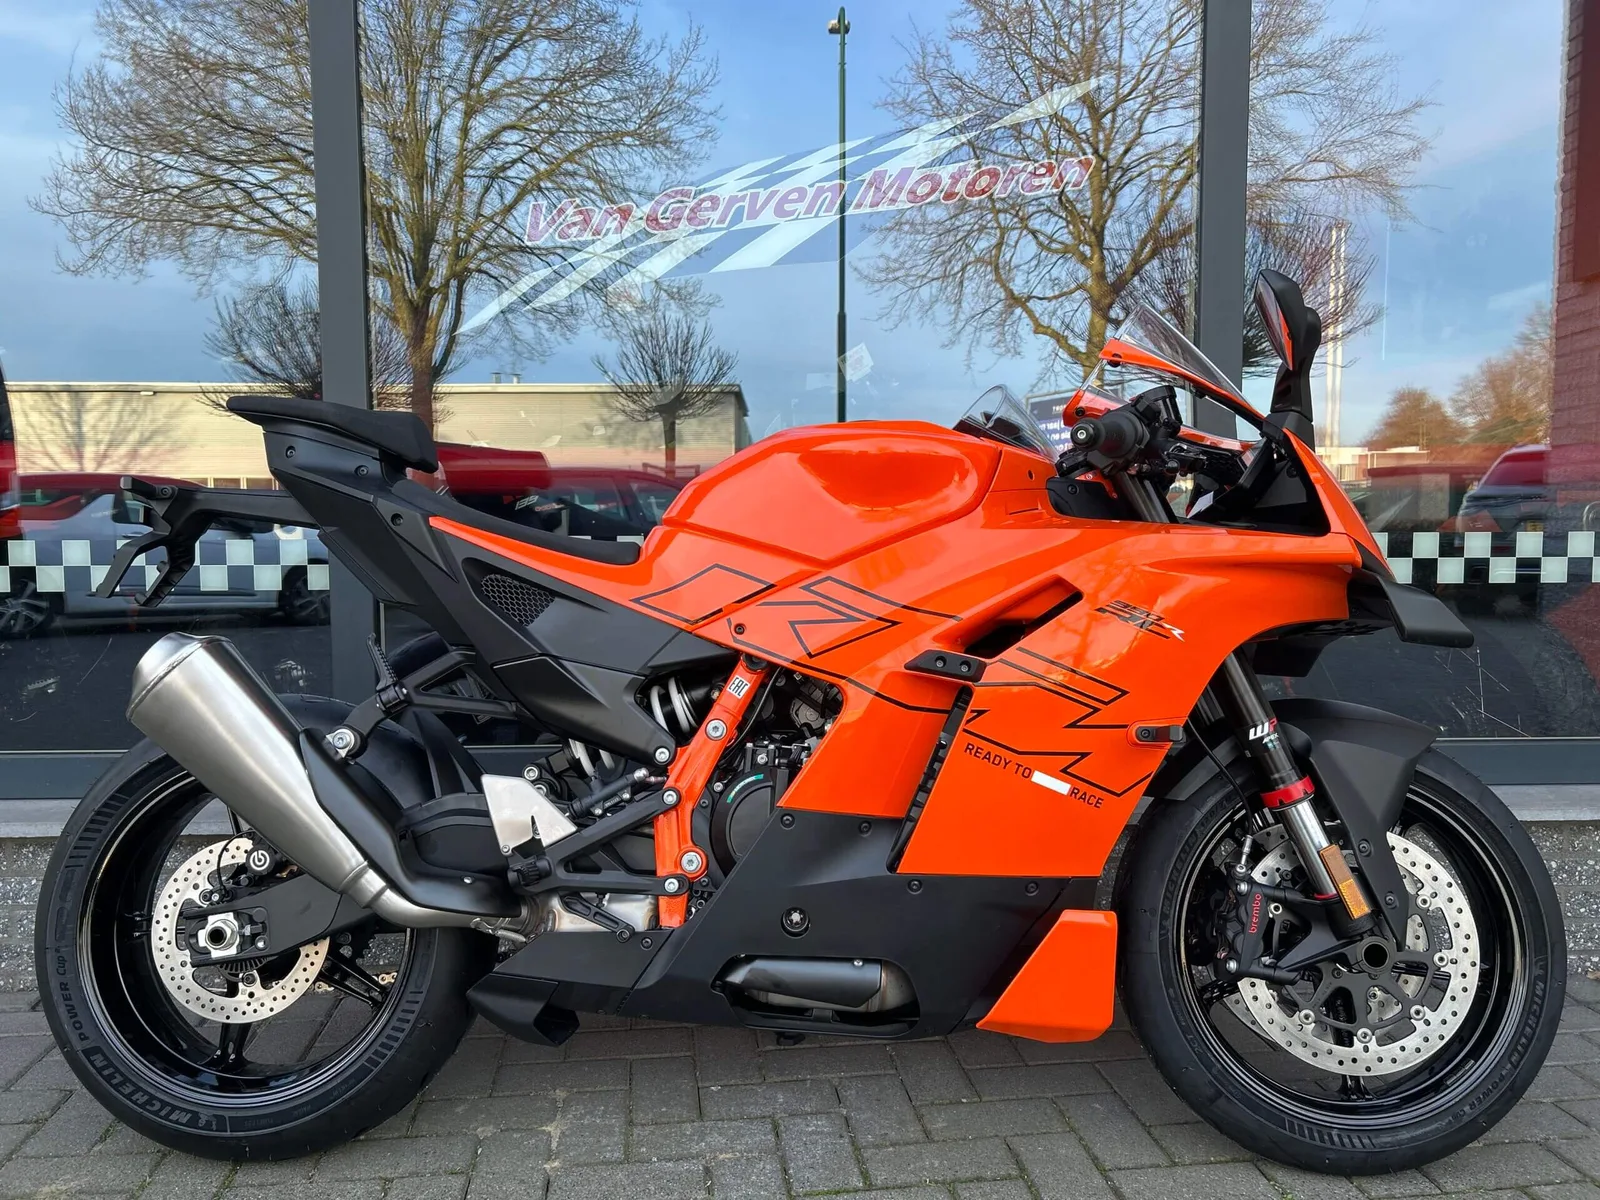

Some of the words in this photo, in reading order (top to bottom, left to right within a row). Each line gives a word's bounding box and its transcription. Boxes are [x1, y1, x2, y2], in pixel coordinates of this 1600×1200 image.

[524, 198, 635, 245] Van
[644, 180, 845, 234] Gerven
[853, 153, 1096, 211] Motoren
[1248, 717, 1278, 741] WP
[964, 742, 1011, 770] READY
[1014, 763, 1032, 779] TO
[1069, 787, 1104, 809] RACE
[1248, 893, 1262, 933] brembo
[59, 981, 89, 1042] POWER
[1510, 980, 1545, 1067] MICHELIN
[90, 1053, 192, 1124] MICHELIN
[1469, 1072, 1506, 1110] POWER
